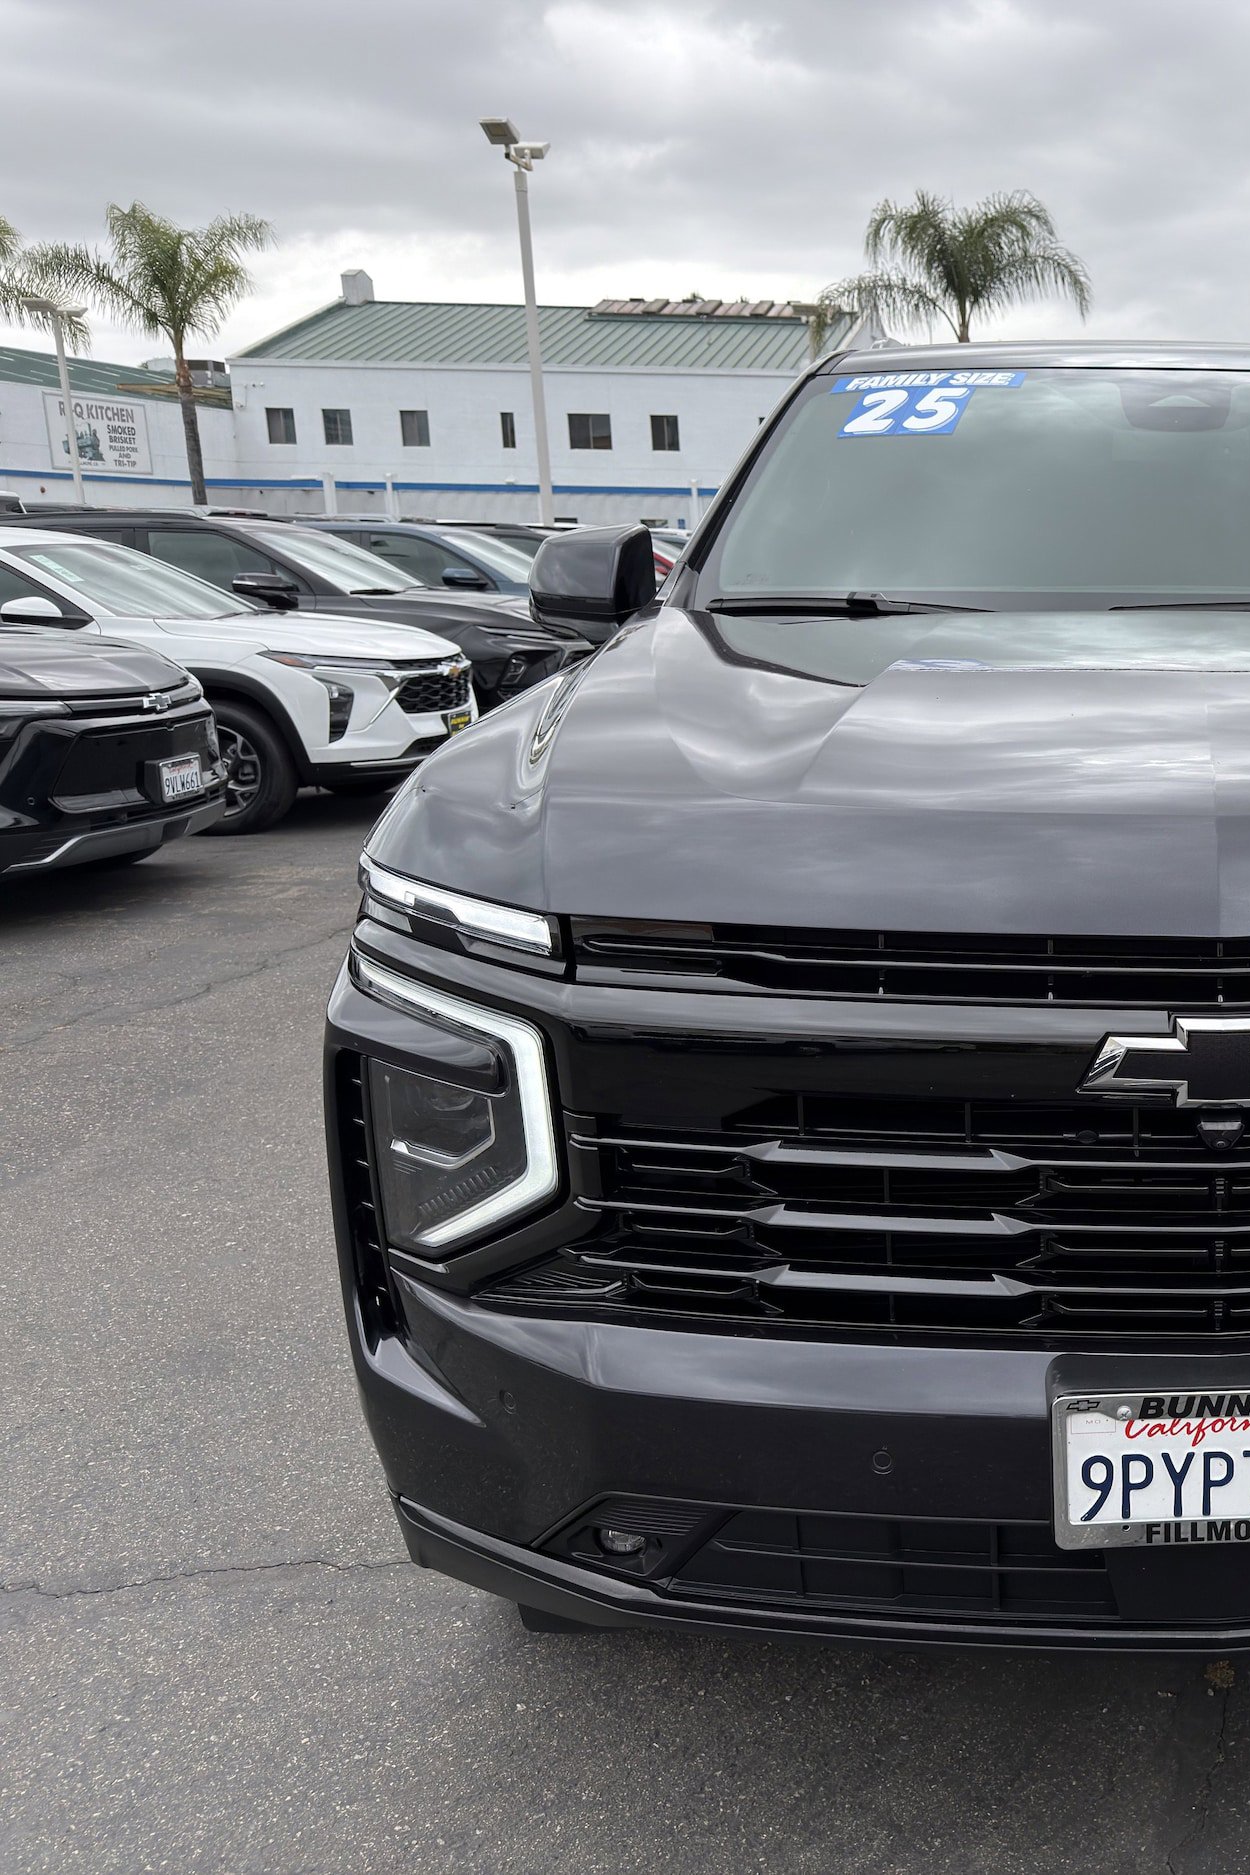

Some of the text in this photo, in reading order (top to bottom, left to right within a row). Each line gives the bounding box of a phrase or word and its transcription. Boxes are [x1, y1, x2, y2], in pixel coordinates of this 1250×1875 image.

[846, 372, 1015, 391] FAMILY SIZE
[86, 404, 135, 423] KITCHEN
[843, 387, 970, 434] 25
[107, 424, 136, 436] SMOKED
[109, 435, 136, 445] BRISKET
[113, 459, 137, 468] TRI-TIP
[165, 771, 199, 795] 9VLW661
